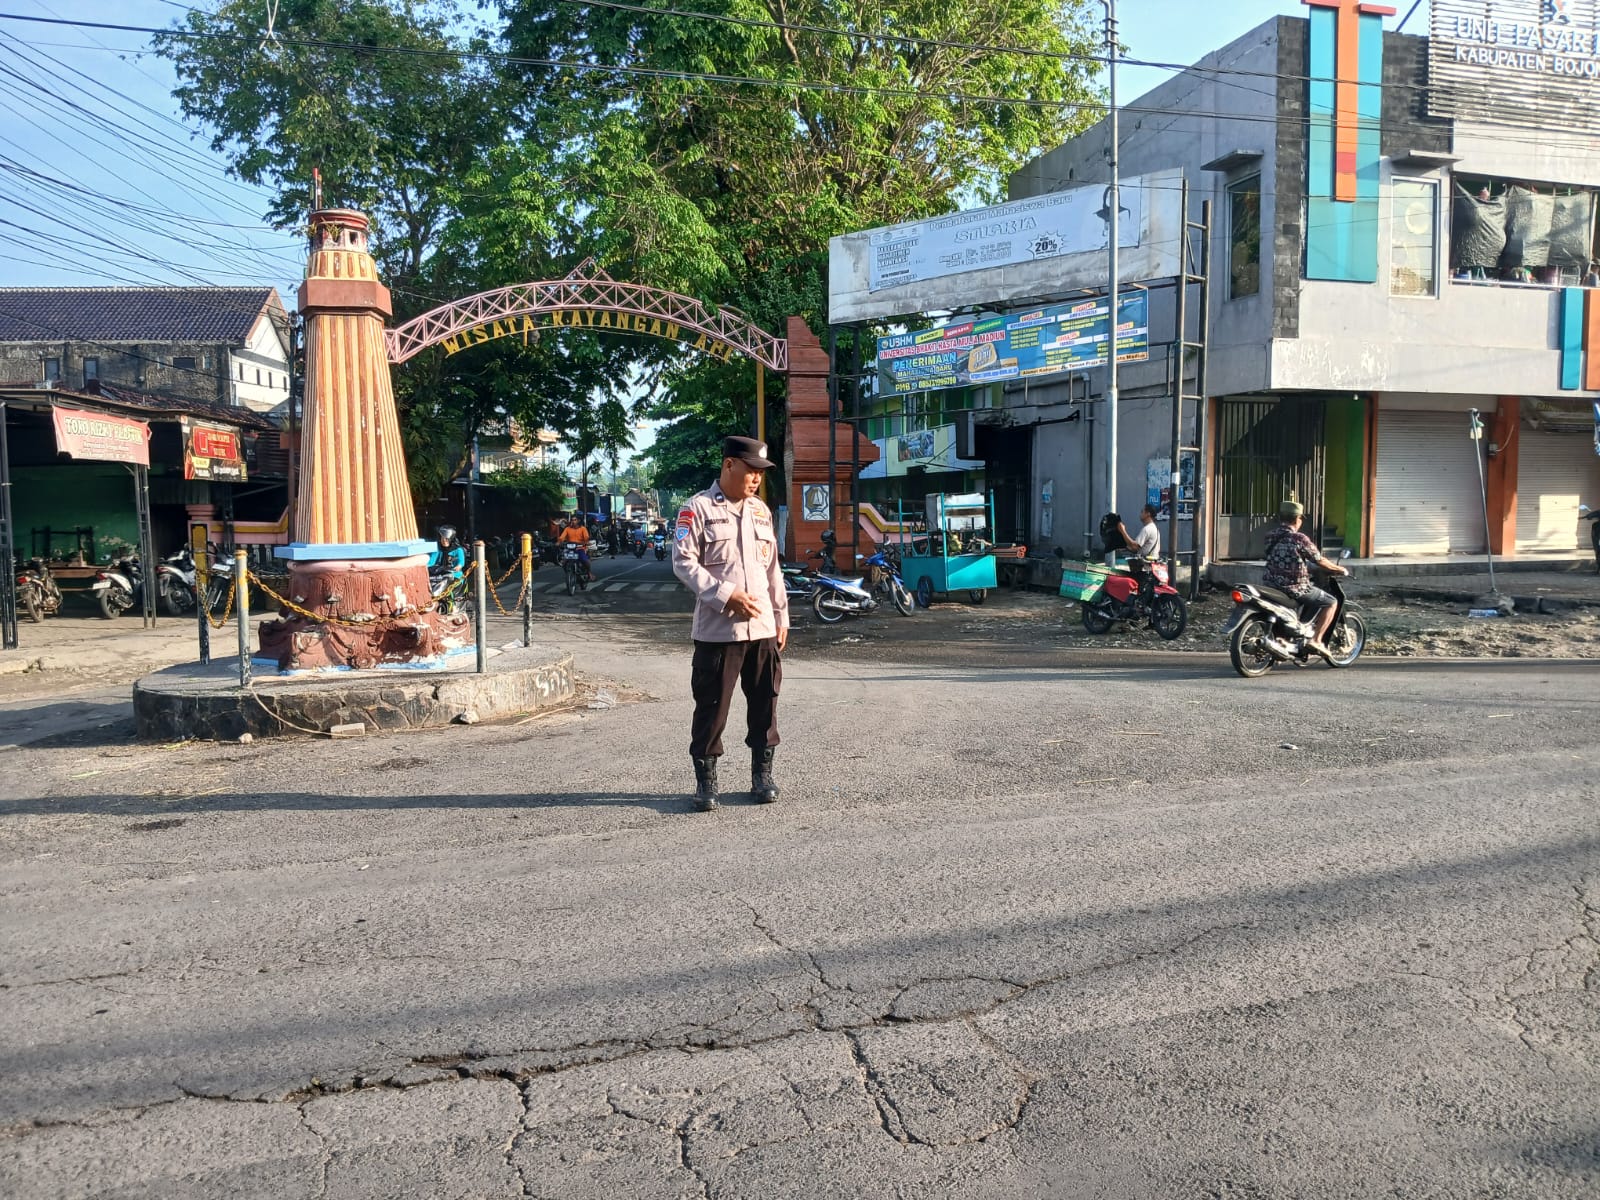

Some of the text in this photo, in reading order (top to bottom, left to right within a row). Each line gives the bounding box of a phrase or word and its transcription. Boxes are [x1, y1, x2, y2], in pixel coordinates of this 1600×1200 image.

[1515, 23, 1587, 53] PASAR
[1456, 46, 1545, 71] KABUPATEN
[1035, 240, 1058, 253] 20%
[440, 313, 535, 355] WISATA
[552, 308, 681, 340] KAYANGAN
[979, 329, 1006, 344] MADIUN
[65, 416, 89, 436] TOKO
